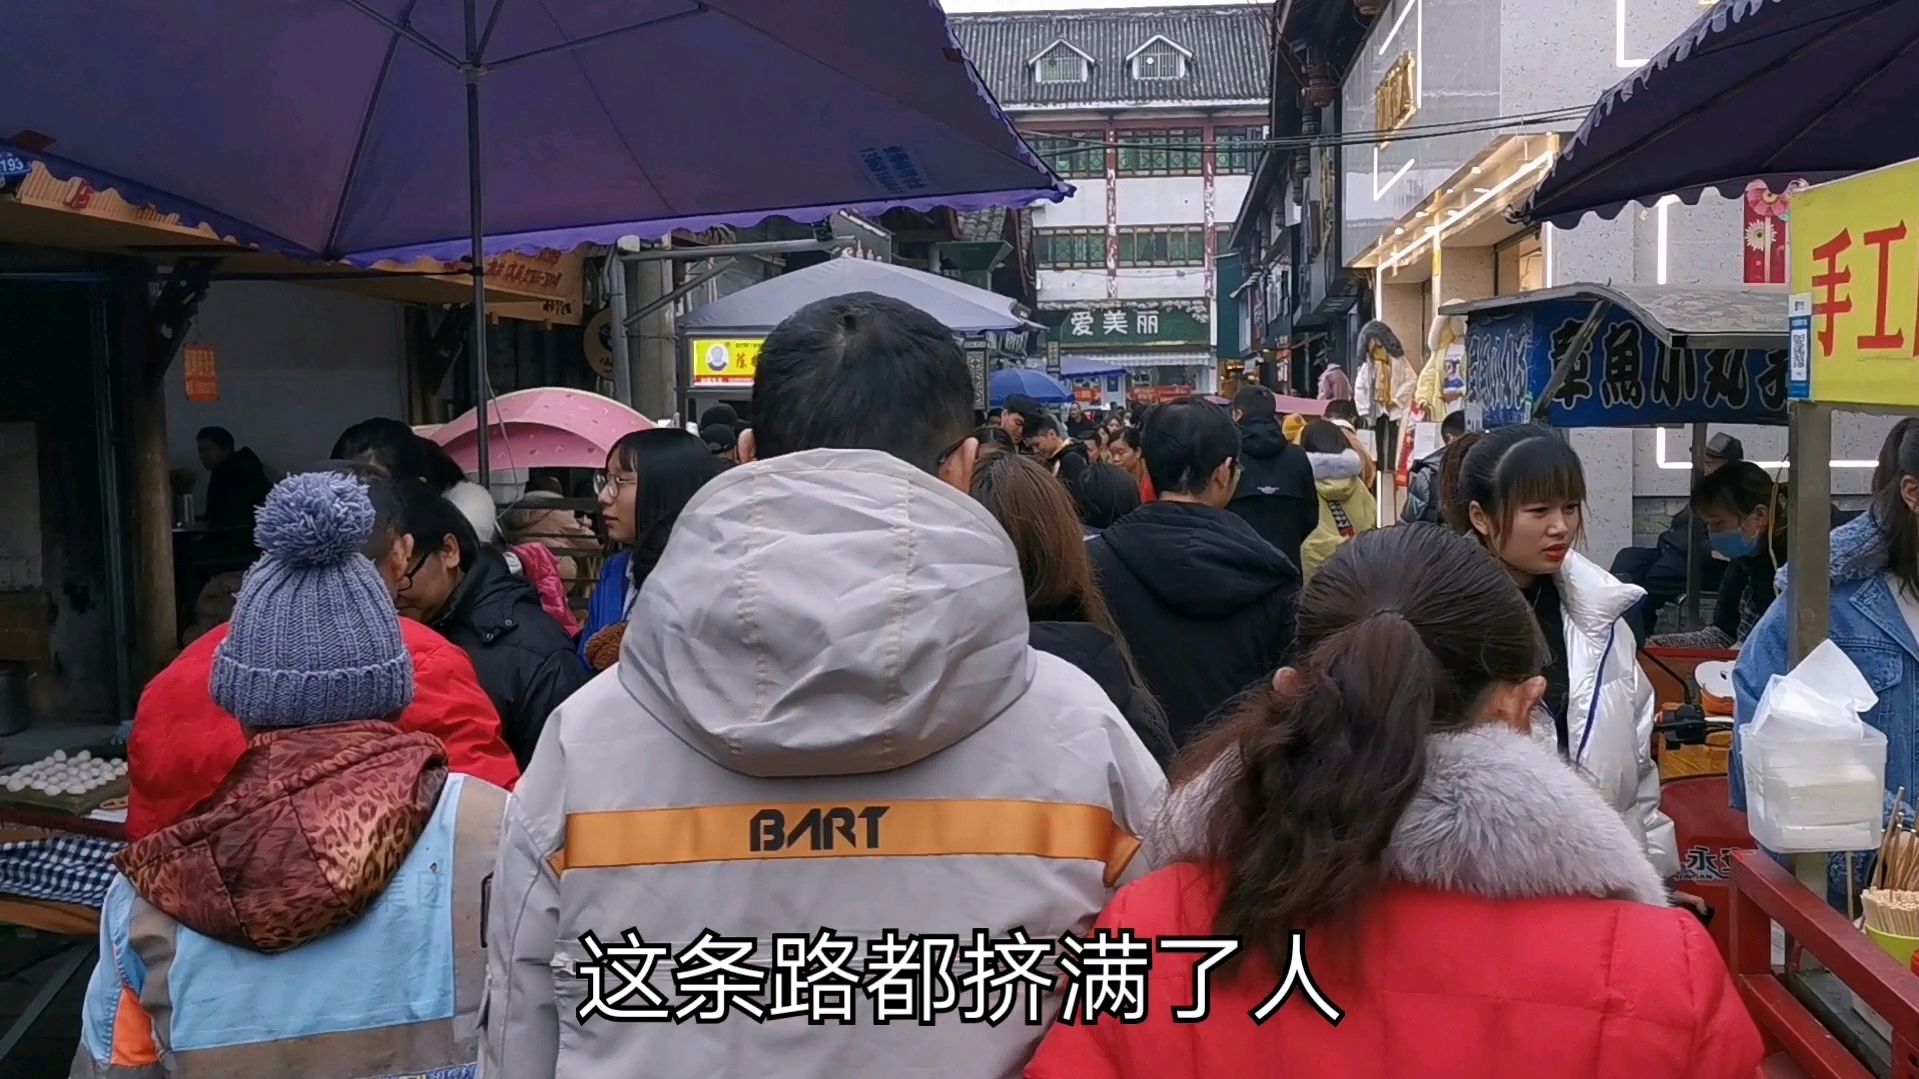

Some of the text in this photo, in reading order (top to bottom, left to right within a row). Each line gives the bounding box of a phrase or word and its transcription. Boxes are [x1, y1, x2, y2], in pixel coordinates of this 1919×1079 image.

[1811, 217, 1919, 358] 手工
[1071, 311, 1159, 336] 爱美丽
[750, 806, 890, 852] BART
